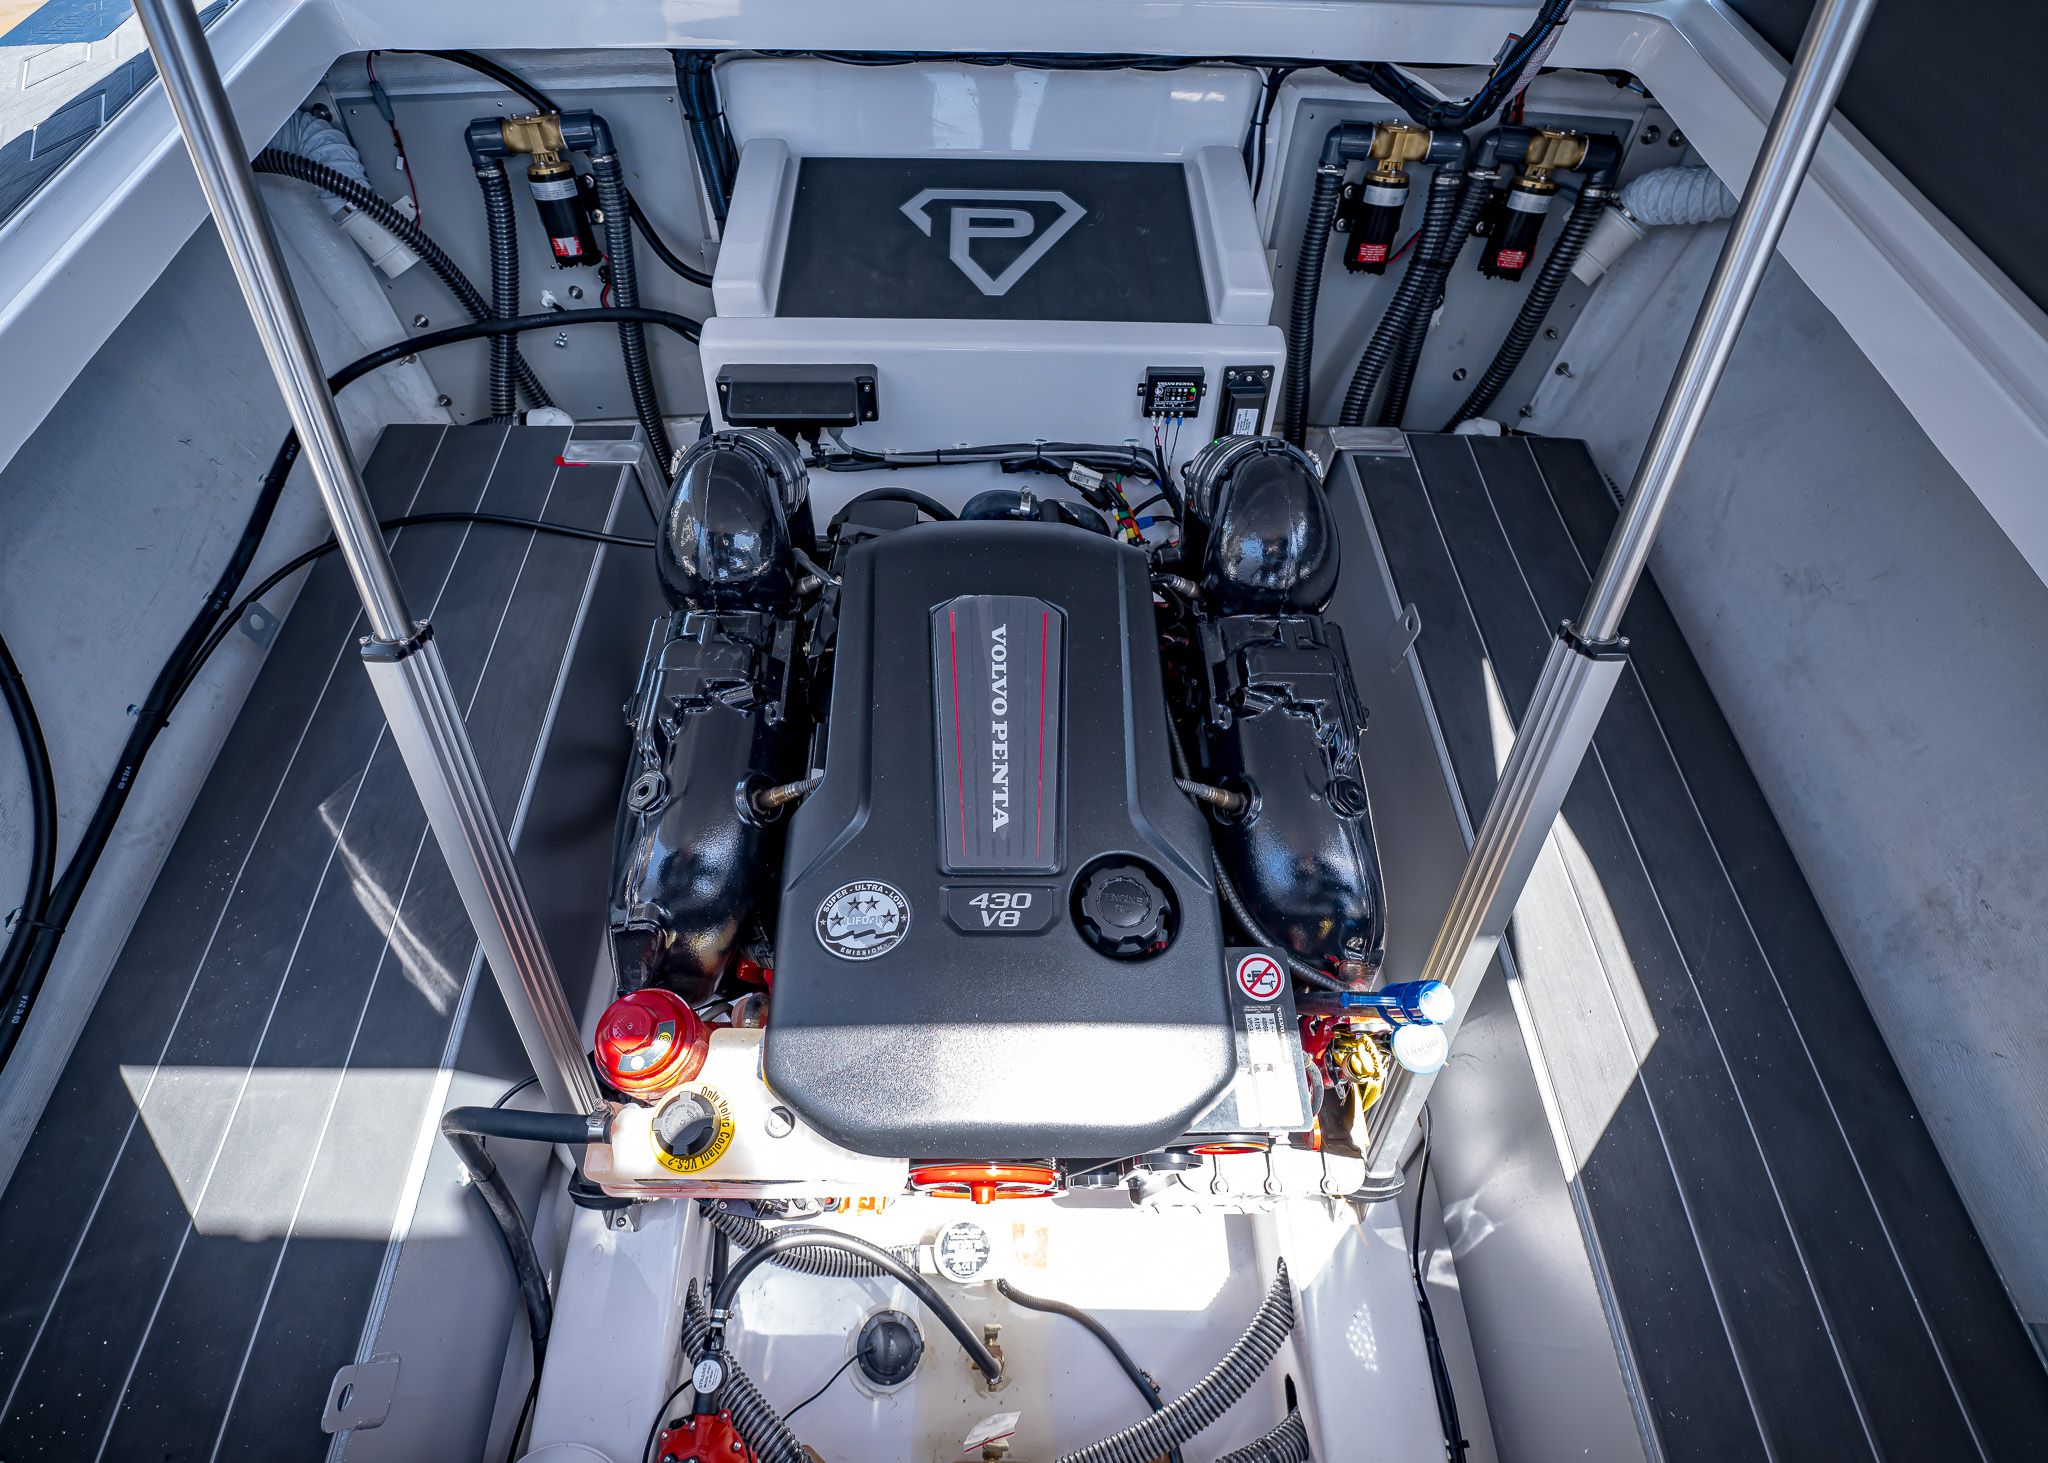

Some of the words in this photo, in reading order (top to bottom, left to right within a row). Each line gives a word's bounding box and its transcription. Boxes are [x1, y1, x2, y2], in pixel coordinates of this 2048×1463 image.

[991, 623, 1008, 716] VOLVO
[991, 720, 1010, 833] PENTA
[823, 888, 849, 913] SUPER
[854, 883, 884, 893] ULTRA
[888, 891, 906, 910] LOW
[968, 892, 1032, 909] 430
[1105, 893, 1144, 906] ENGINE
[980, 910, 1021, 928] V8
[1277, 1006, 1285, 1033] VOLVO
[700, 1086, 720, 1103] Only
[718, 1099, 732, 1128] Volvo
[700, 1131, 731, 1166] Coolant
[667, 1157, 698, 1170] VCS-2
